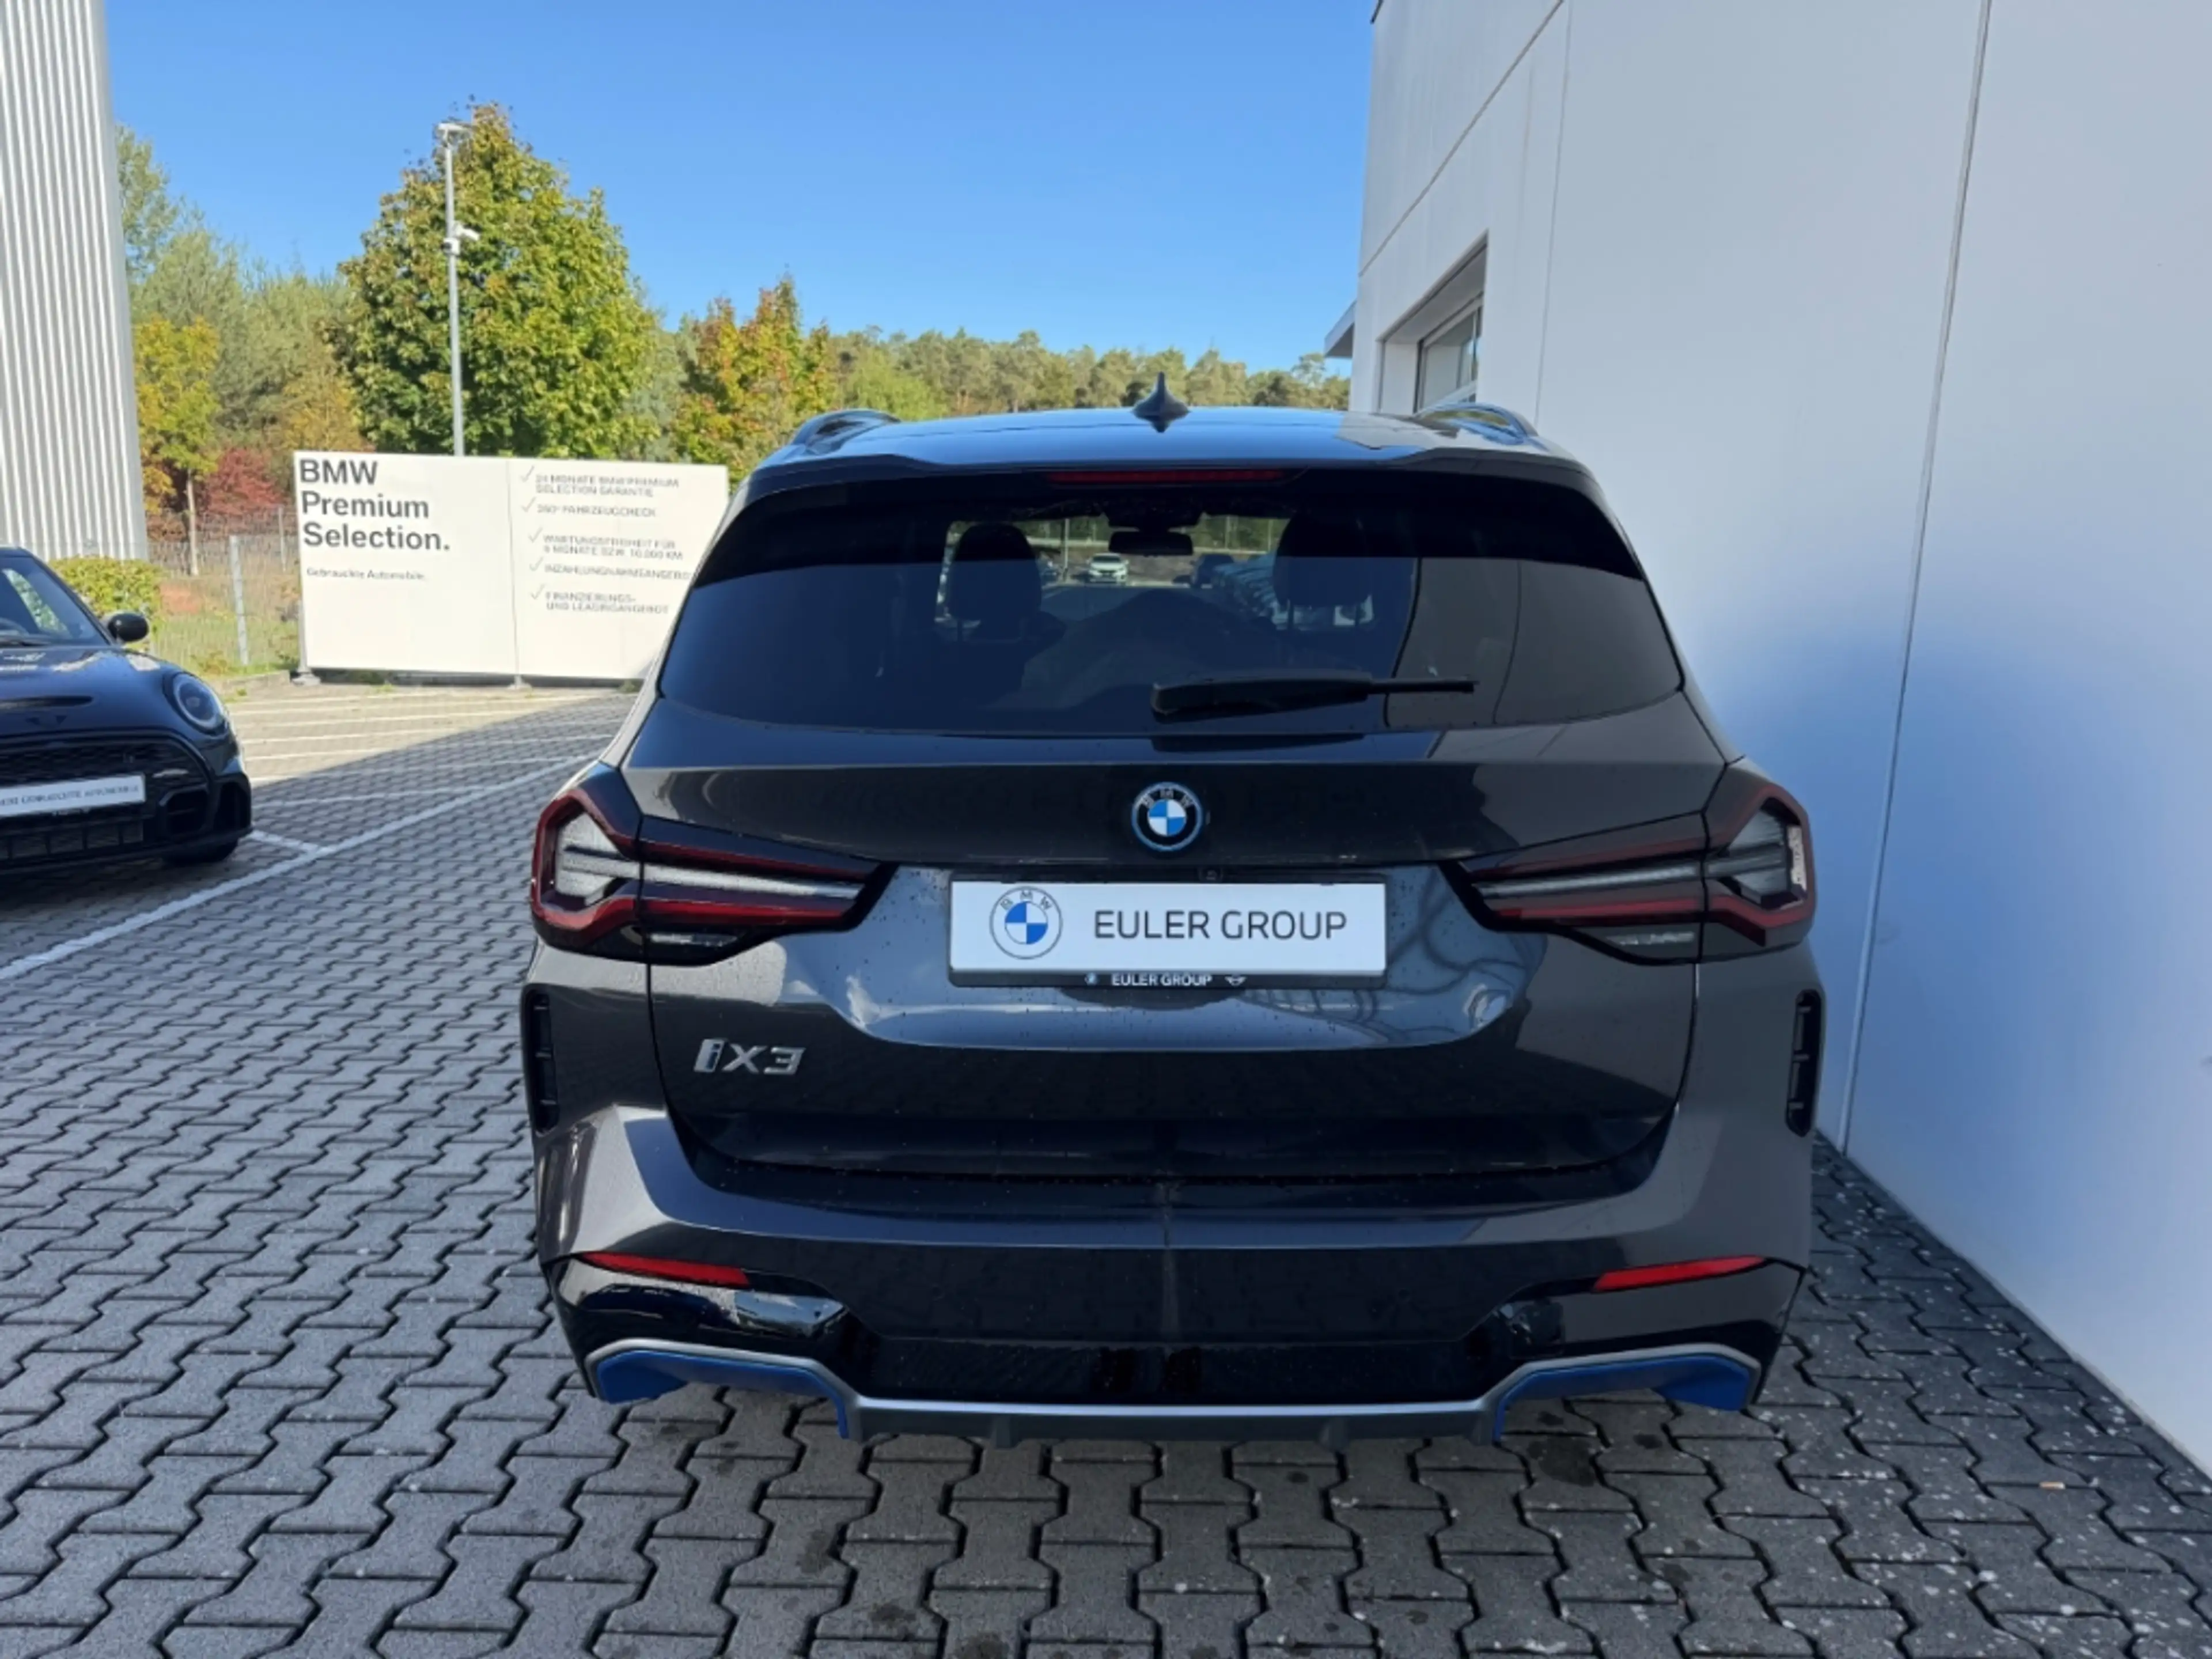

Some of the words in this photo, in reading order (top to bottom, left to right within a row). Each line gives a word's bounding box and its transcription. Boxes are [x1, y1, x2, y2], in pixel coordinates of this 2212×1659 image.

[300, 459, 378, 485] BMW
[301, 490, 429, 518] Premium
[303, 521, 450, 551] Selection.
[1142, 788, 1193, 808] BMW
[1000, 889, 1052, 911] BMW
[1094, 910, 1210, 940] EULER
[1221, 910, 1347, 942] GROUP
[1111, 973, 1159, 986] EULER
[1160, 973, 1213, 986] GROUP
